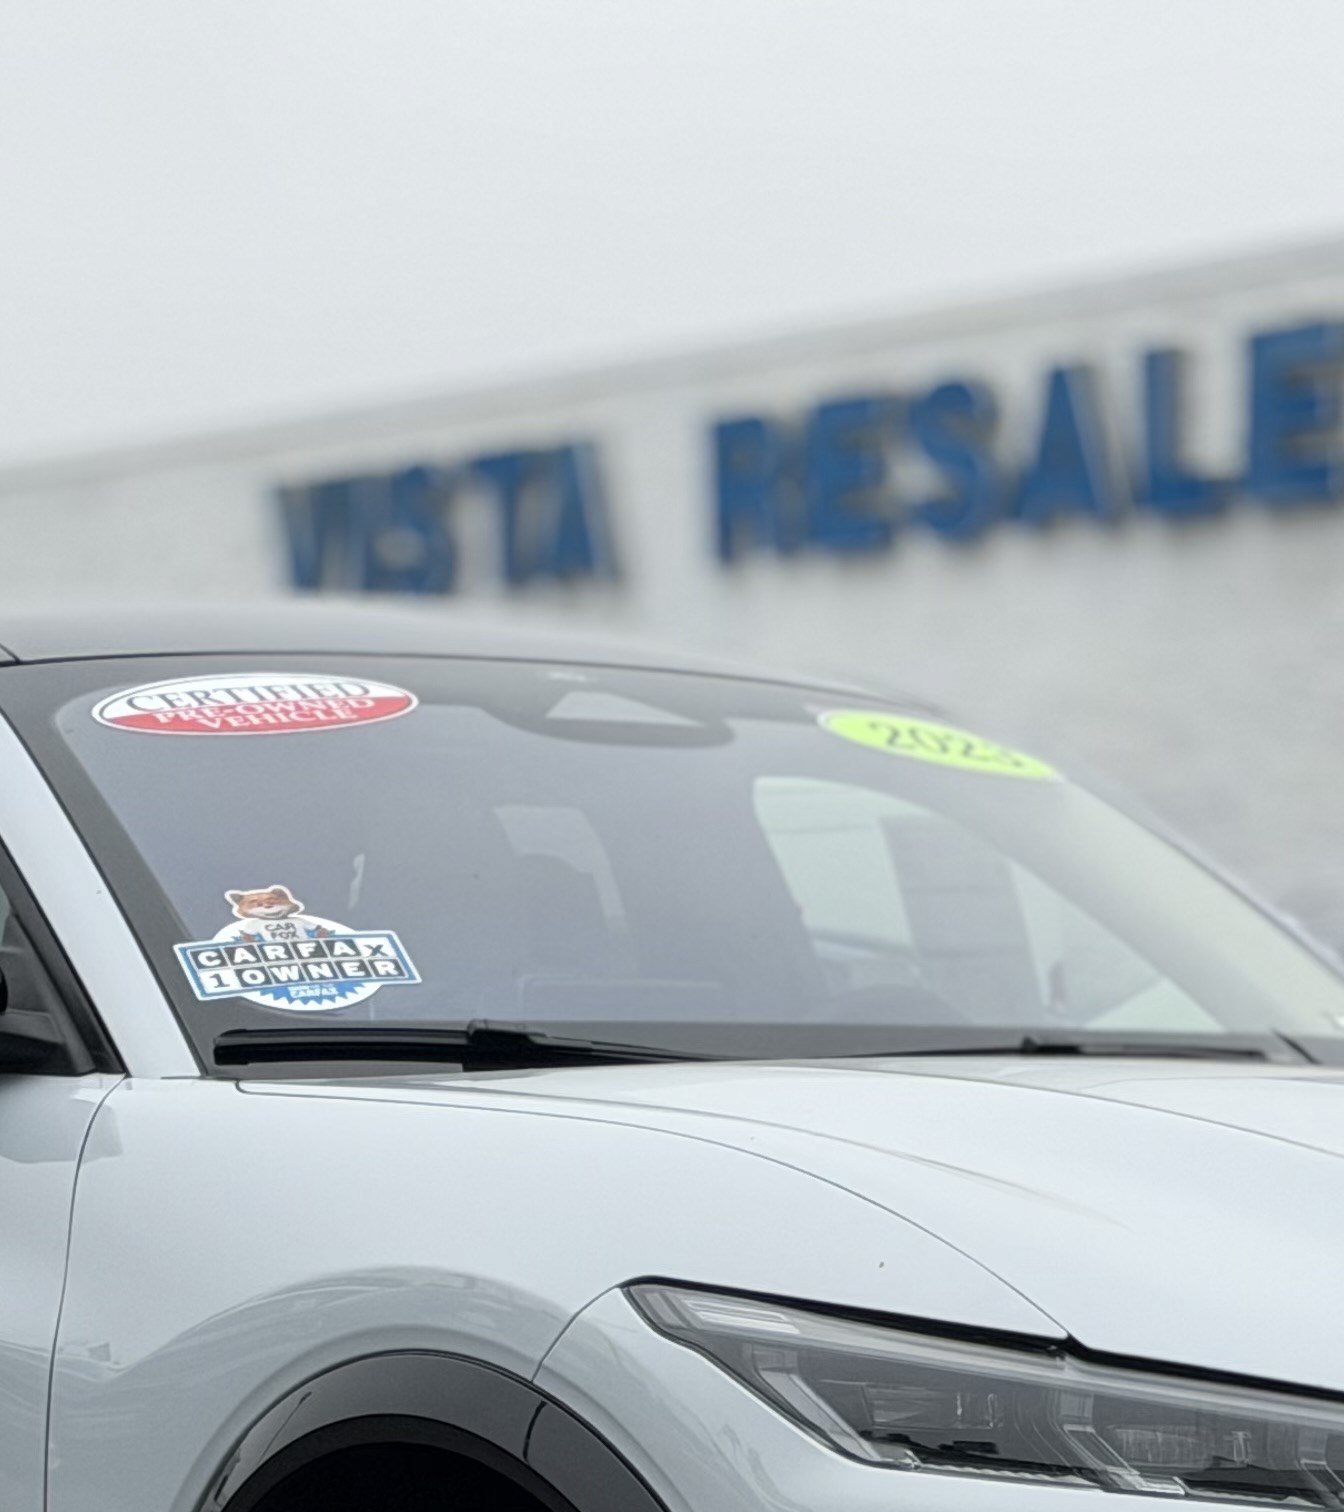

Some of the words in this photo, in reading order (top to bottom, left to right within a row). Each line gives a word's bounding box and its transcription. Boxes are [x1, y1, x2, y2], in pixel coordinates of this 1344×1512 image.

[276, 440, 621, 598] VISTA
[126, 682, 371, 712] CERTIFIED
[155, 696, 376, 725] PRE-OWNED
[195, 707, 358, 730] VEHICLE
[264, 921, 297, 933] CAR
[269, 930, 301, 941] FOX
[196, 941, 391, 968] CARFAX
[212, 972, 231, 989] 1
[241, 960, 399, 985] OWNER
